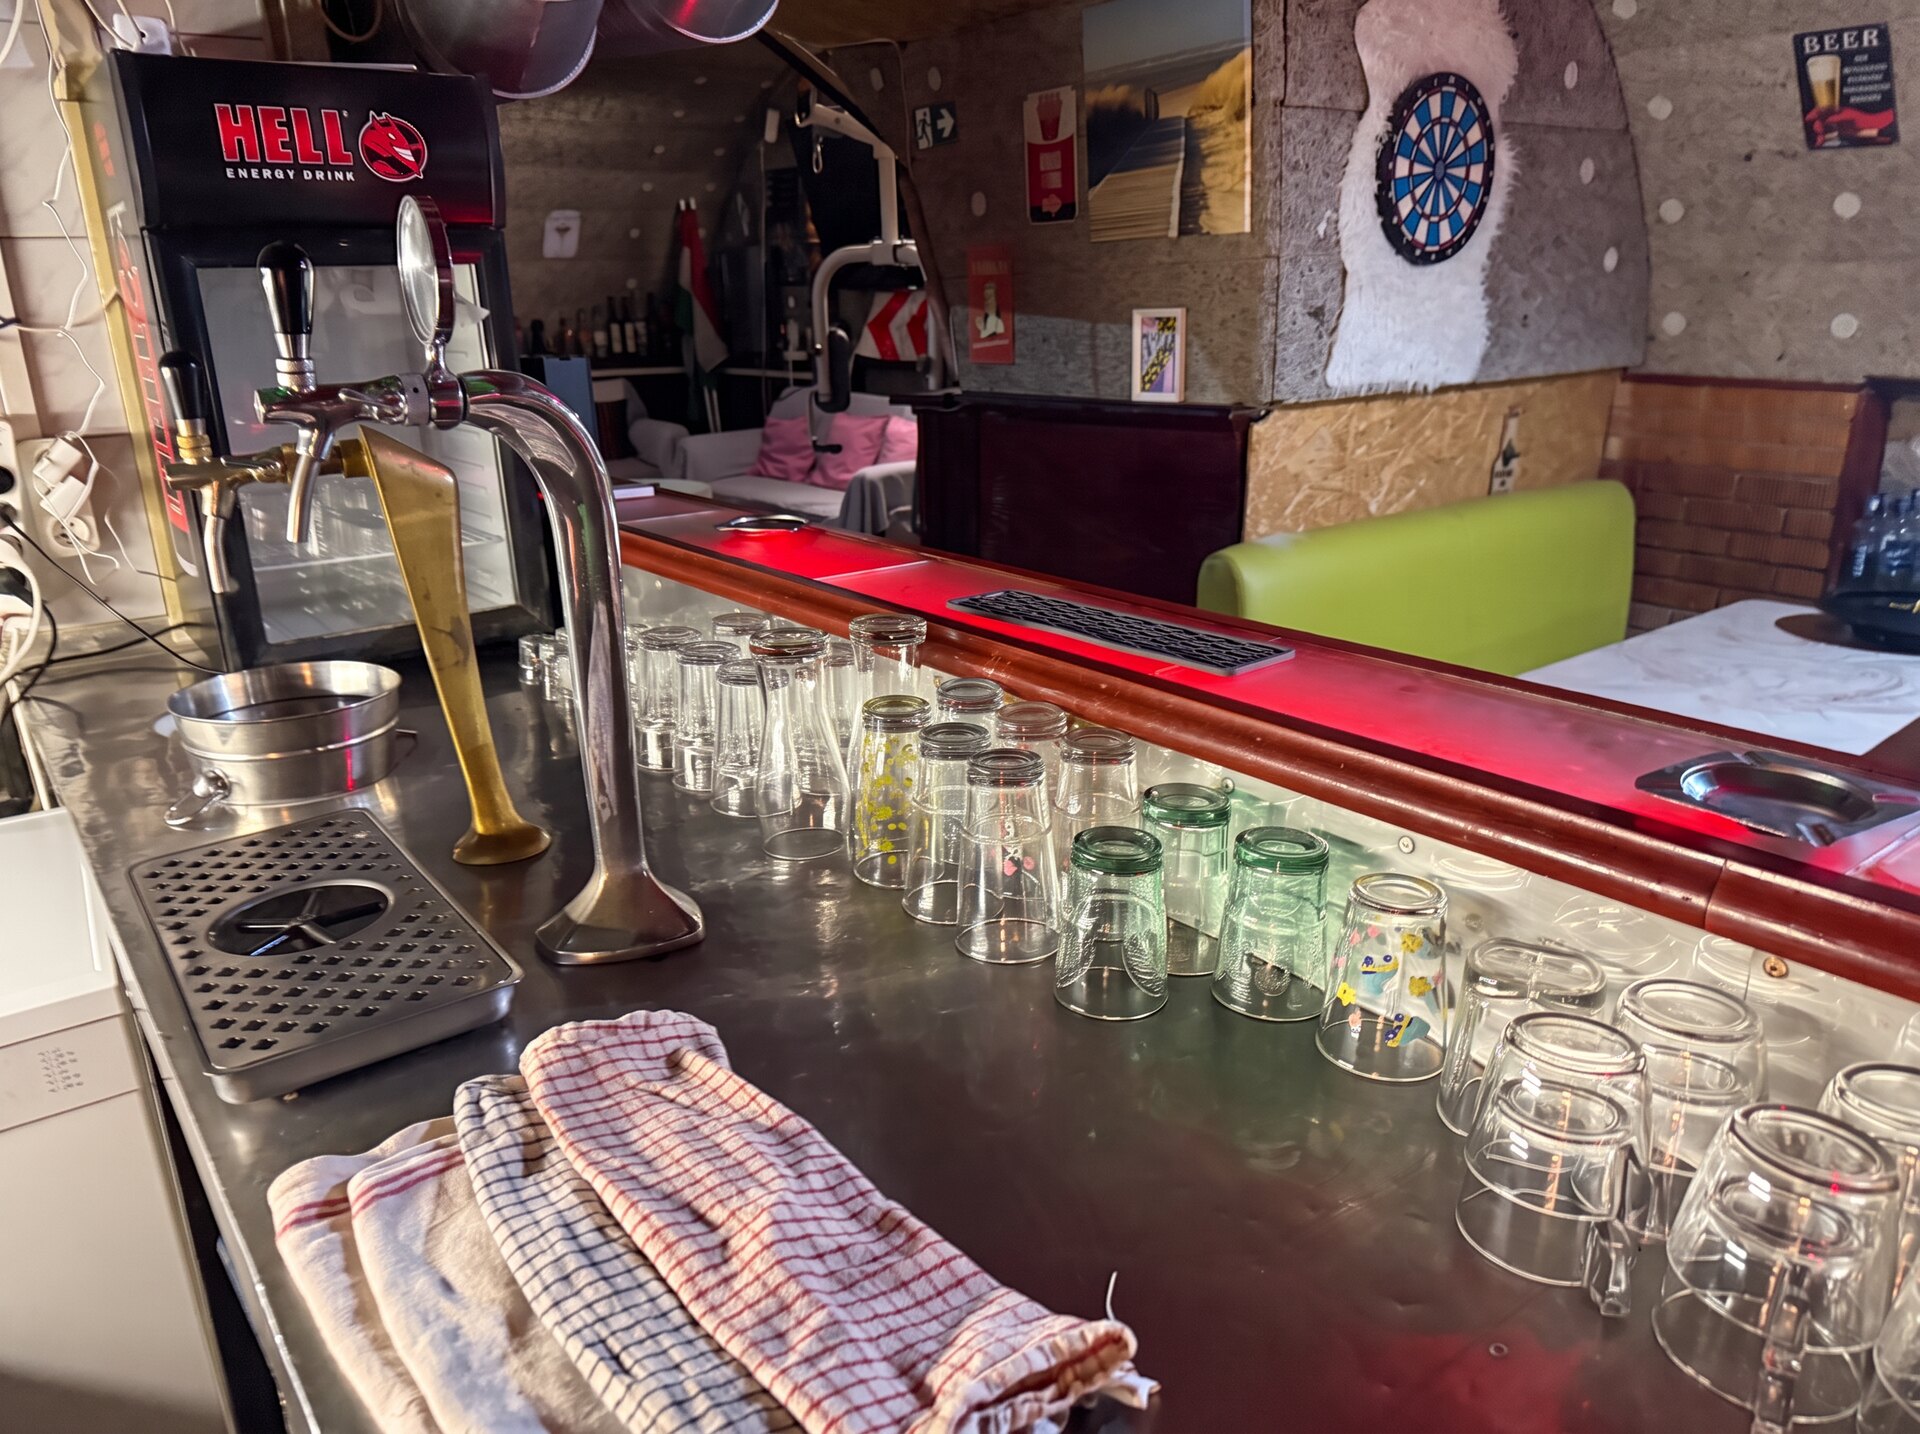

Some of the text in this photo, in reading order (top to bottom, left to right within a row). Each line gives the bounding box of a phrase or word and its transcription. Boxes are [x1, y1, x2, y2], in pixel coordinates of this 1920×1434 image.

[1803, 28, 1879, 54] BEER
[214, 103, 353, 165] HELL
[225, 168, 355, 182] ENERGY DRINK
